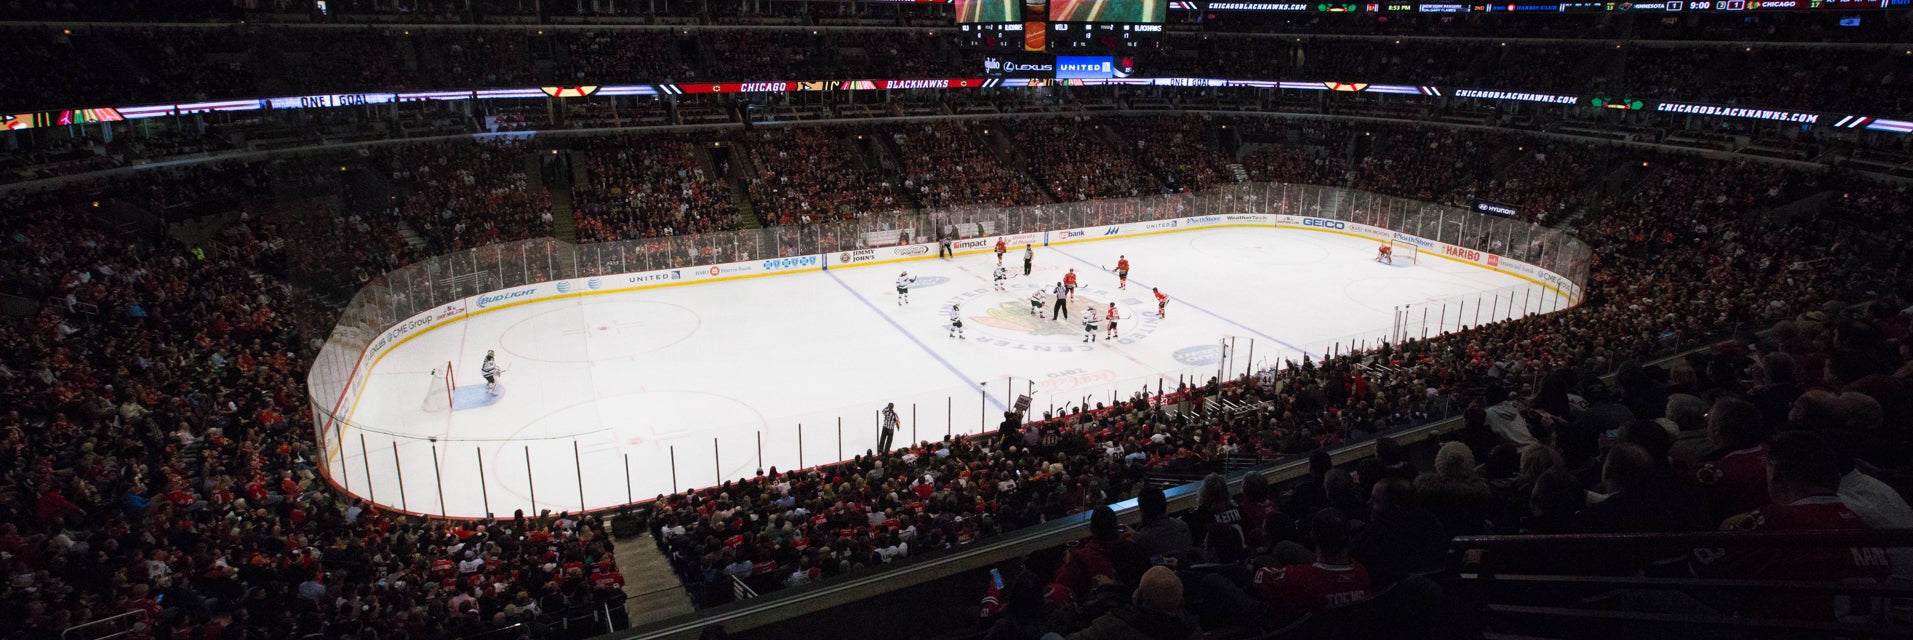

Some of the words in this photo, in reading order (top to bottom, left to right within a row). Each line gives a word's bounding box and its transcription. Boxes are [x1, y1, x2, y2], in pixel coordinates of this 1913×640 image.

[1690, 2, 1710, 10] 9:00
[740, 82, 787, 92] CHICAGO
[886, 79, 949, 90] BLACKHAWKS
[300, 96, 325, 108] ONE
[1455, 89, 1578, 104] CHICAGOBLACKHAWKS.COM
[1657, 102, 1819, 123] CHICAGOBLACKHAWKS.COM
[1302, 217, 1345, 230] GEICO
[960, 239, 988, 250] impact
[852, 249, 875, 257] JIMMY
[852, 255, 876, 263] JOHN'S
[1446, 246, 1480, 262] HARIBO
[629, 274, 669, 283] UNITED
[481, 294, 504, 306] BUD
[504, 288, 538, 300] LIGHT
[392, 322, 408, 339] CME
[408, 315, 433, 332] Group
[1214, 508, 1242, 524] KEITH
